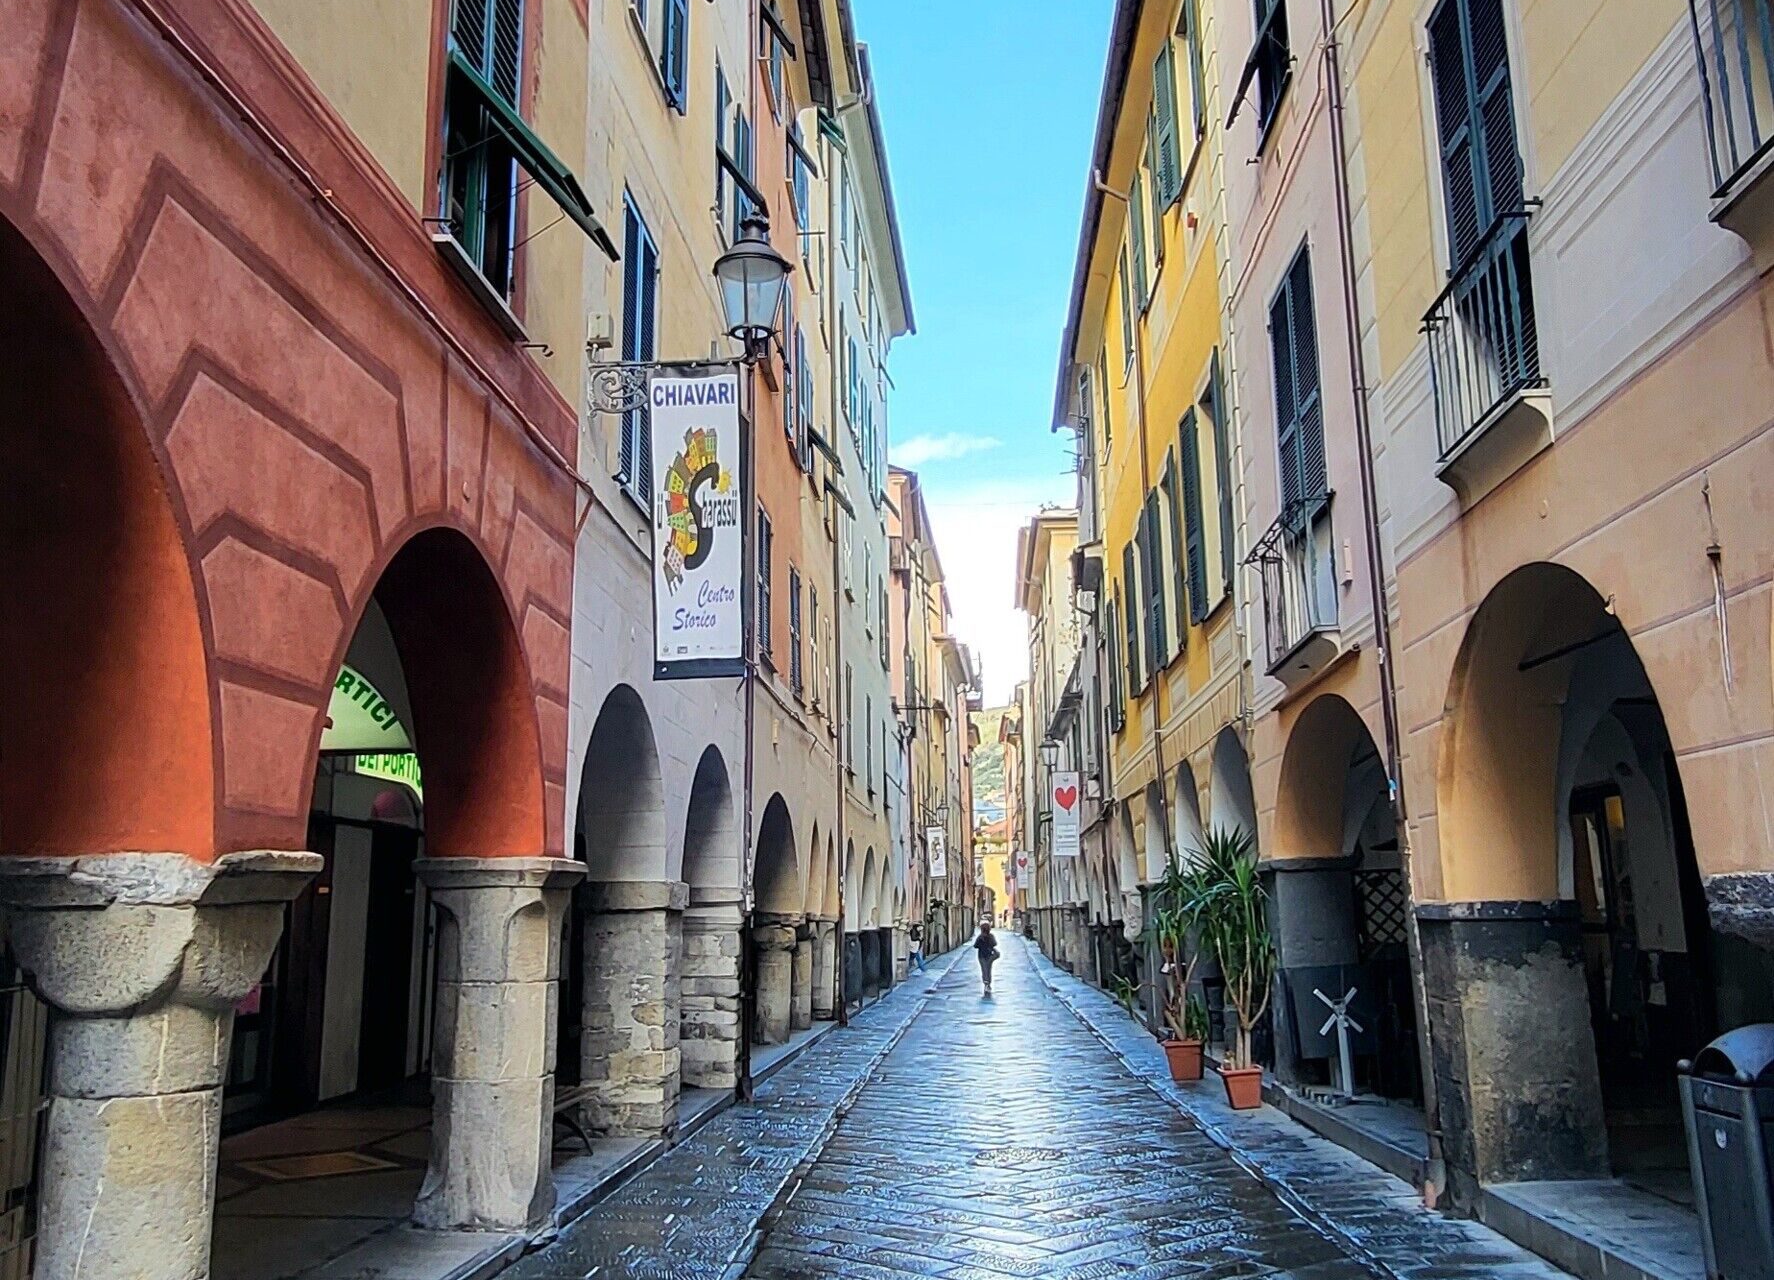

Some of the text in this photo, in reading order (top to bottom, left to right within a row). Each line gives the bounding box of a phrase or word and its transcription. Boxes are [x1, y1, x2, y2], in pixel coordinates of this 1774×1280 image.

[653, 383, 735, 407] CHIAVARI
[697, 579, 735, 608] Centro
[672, 608, 716, 631] Storico
